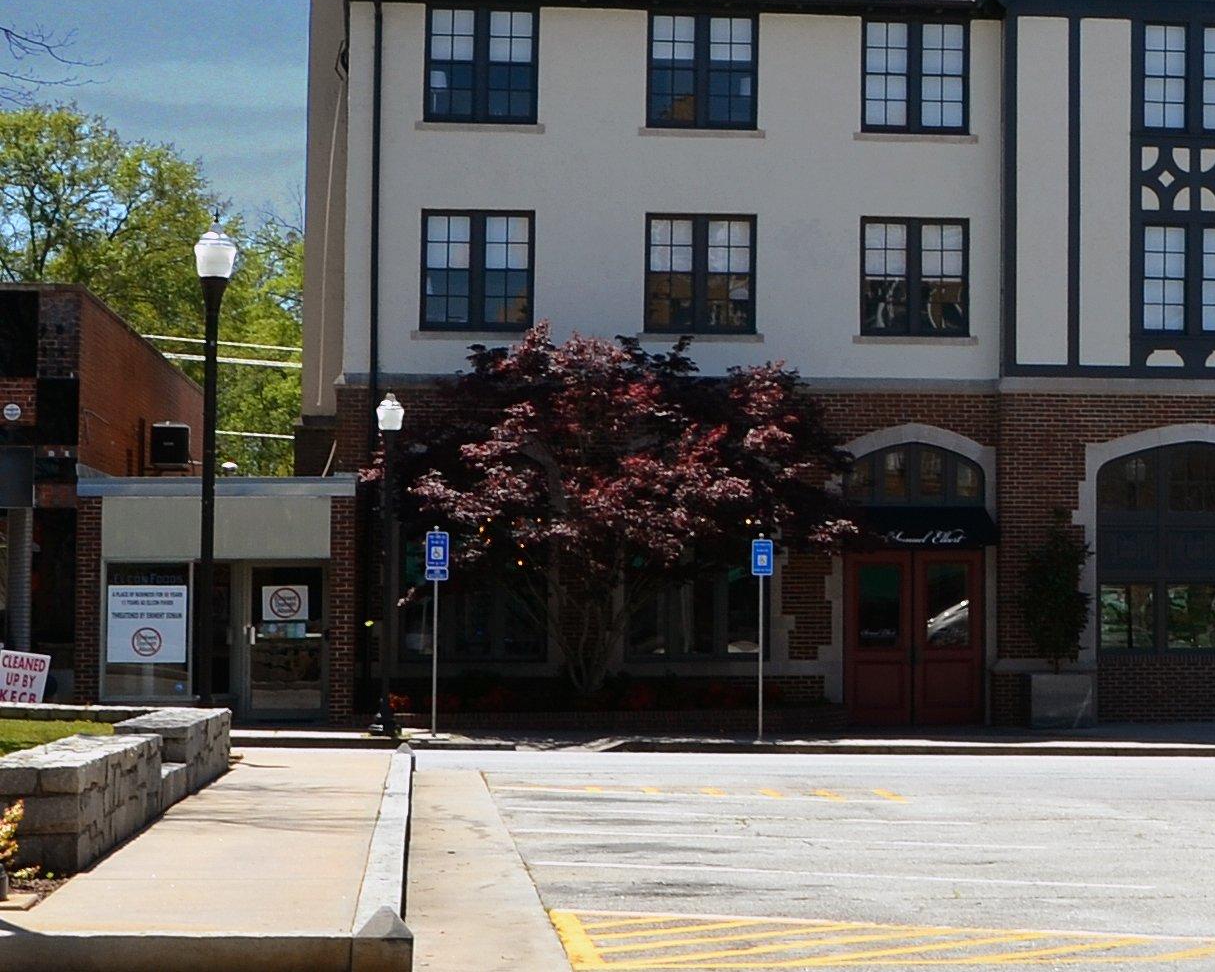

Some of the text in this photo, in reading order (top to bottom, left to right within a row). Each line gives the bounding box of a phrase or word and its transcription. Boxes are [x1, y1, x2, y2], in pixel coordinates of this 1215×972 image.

[2, 654, 46, 673] CLEANED
[6, 673, 36, 689] UP BY
